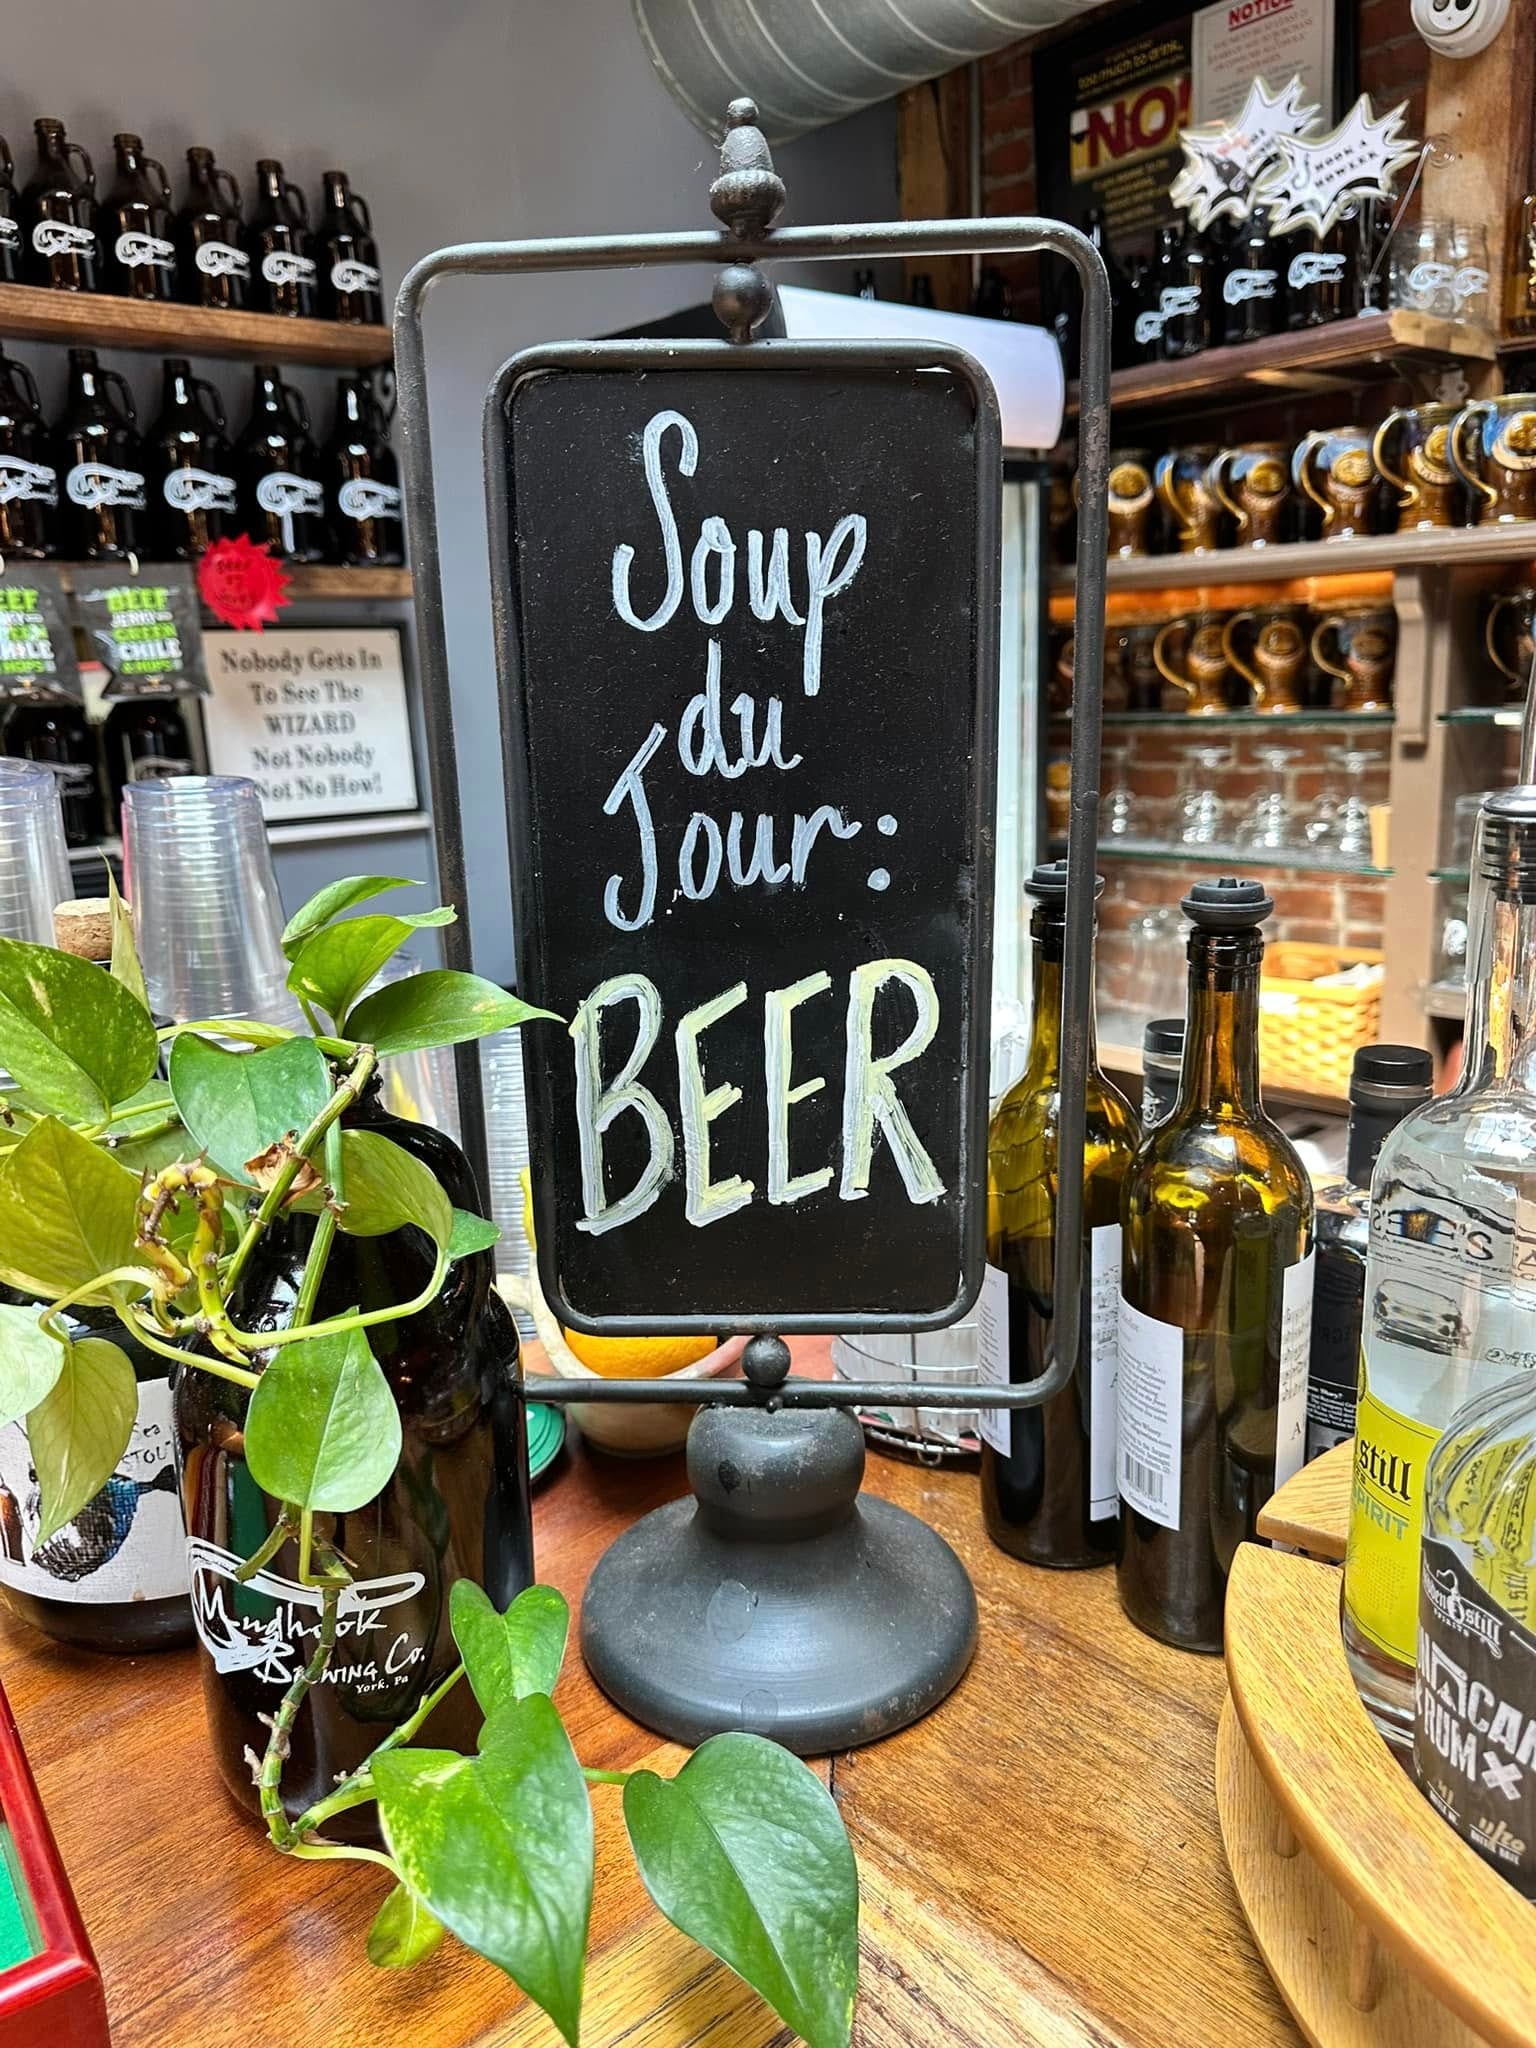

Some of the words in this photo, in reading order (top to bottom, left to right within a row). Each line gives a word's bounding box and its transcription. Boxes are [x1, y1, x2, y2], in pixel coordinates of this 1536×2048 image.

[1087, 73, 1193, 168] NO!
[612, 410, 867, 697] Soup
[107, 587, 168, 613] BEEF
[220, 648, 302, 675] Nobody
[308, 647, 356, 671] Gets
[359, 647, 382, 670] In
[249, 681, 277, 704] To
[280, 679, 320, 703] See
[322, 679, 363, 702] The
[679, 638, 804, 779] du
[263, 710, 356, 736] WIZARD
[252, 747, 292, 770] Not
[295, 741, 375, 768] Nobody
[253, 778, 292, 800] Not
[295, 776, 327, 799] No
[329, 771, 383, 798] How!
[603, 723, 899, 932] Jour:
[568, 958, 949, 1237] BEER
[253, 1636, 378, 1684] BRWING
[385, 1633, 425, 1675] Co.
[1424, 1686, 1477, 1782] RUM
